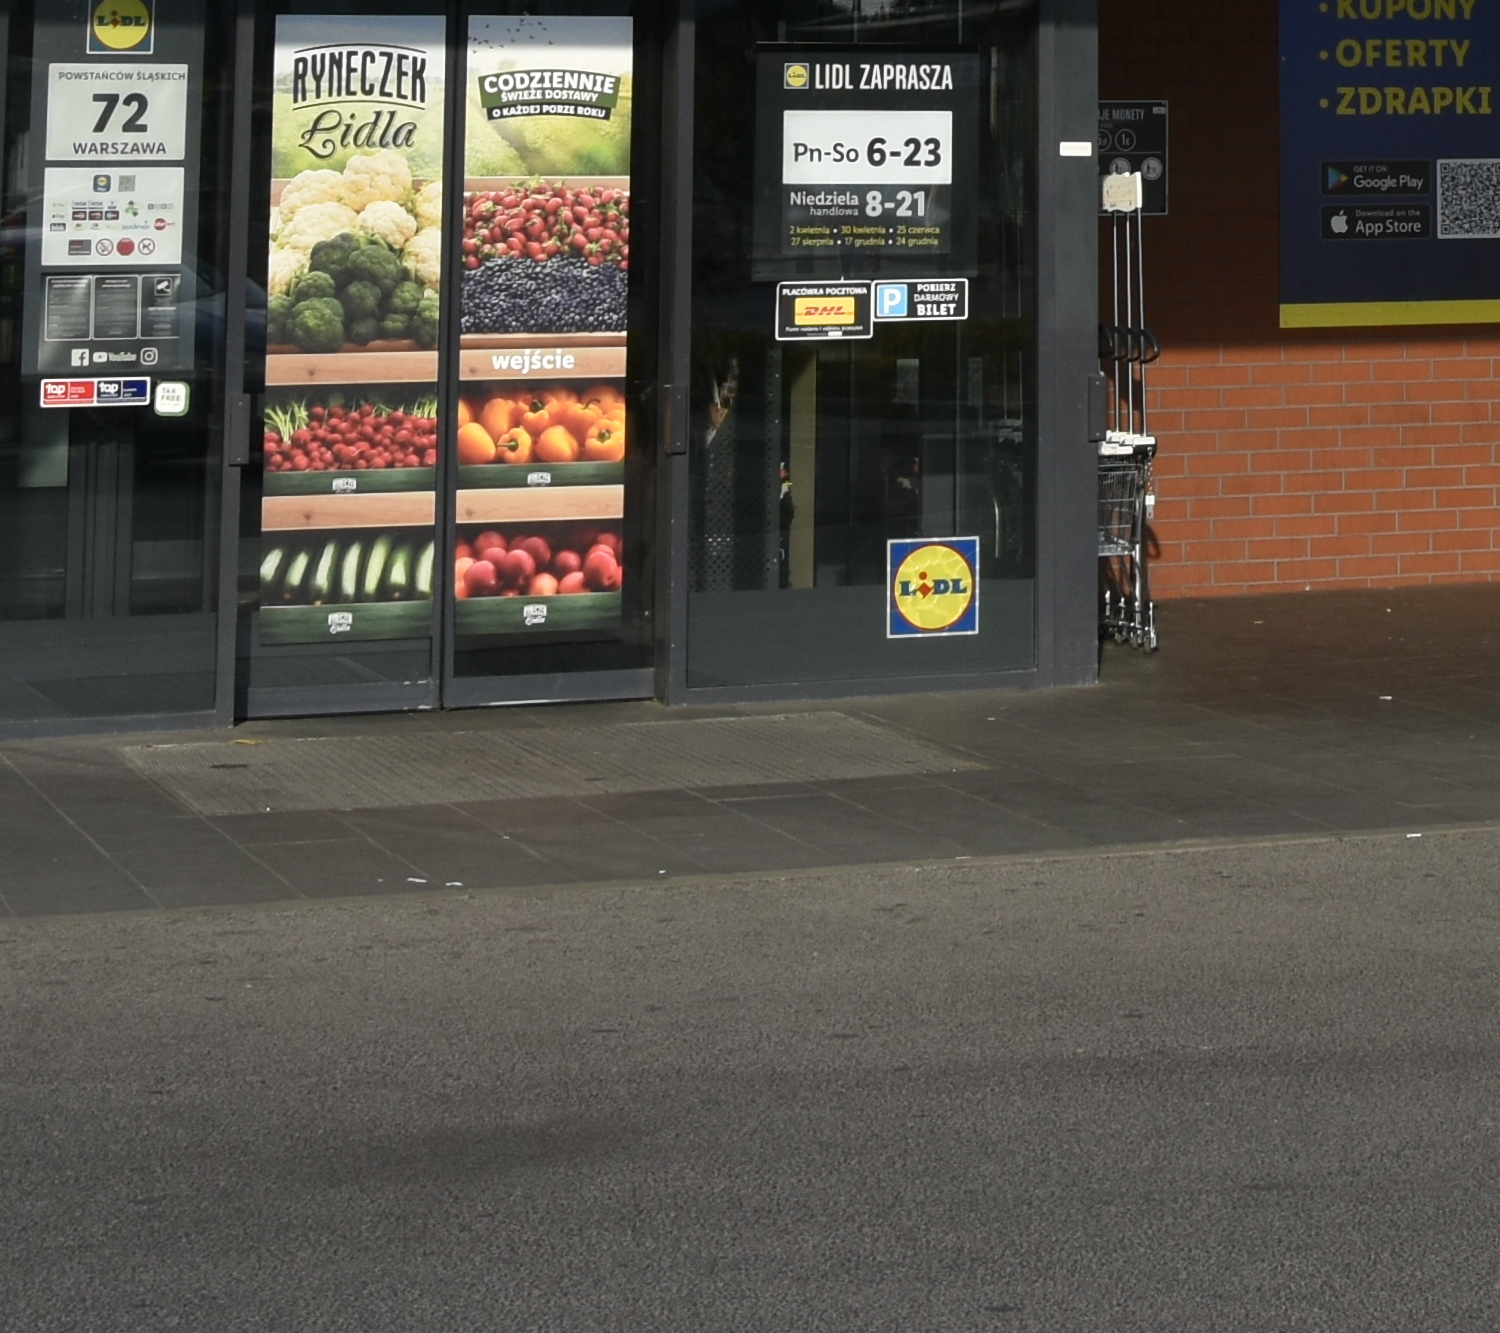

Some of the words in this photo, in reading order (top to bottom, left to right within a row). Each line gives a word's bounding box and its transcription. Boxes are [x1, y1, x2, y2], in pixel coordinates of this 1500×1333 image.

[96, 10, 146, 28] LIDL
[1335, 39, 1471, 68] OFERTY
[58, 71, 134, 81] POWSTAŃCÓW
[137, 71, 186, 82] ŚLĄSKICH
[292, 50, 427, 103] RYNECZEK
[483, 72, 616, 94] CODZIENNIE
[814, 64, 854, 90] LIDL
[859, 64, 953, 90] ZAPRASZA
[501, 88, 543, 102] ŚWIEŻE
[545, 90, 599, 103] DOSTAWY
[1335, 86, 1492, 115] ZDRAPKI
[92, 92, 149, 133] 72
[492, 110, 501, 118] O
[502, 104, 541, 117] KAŻDEJ
[542, 105, 575, 116] PORZE
[577, 106, 606, 118] ROKU
[1112, 109, 1145, 120] MONETY
[298, 110, 418, 159] Lidla
[72, 142, 167, 155] WARSZAWA
[793, 143, 860, 163] Pn-So
[867, 137, 942, 167] 6-23
[1353, 174, 1397, 191] Google
[1399, 175, 1424, 191] Play
[790, 191, 859, 205] Niedziela
[865, 190, 926, 217] 8-21
[810, 207, 859, 216] handlowa
[790, 226, 795, 234] 2
[796, 226, 830, 234] kwietnia
[841, 226, 851, 234] 30
[853, 226, 886, 234] kwietnia
[896, 226, 906, 234] 25
[1355, 218, 1383, 236] App
[1384, 218, 1422, 234] Store
[791, 237, 801, 245] 27
[844, 237, 853, 245] 17
[854, 237, 885, 247] grudnia
[896, 237, 906, 245] 24
[907, 237, 938, 247] grudnia
[917, 284, 955, 292] POBIERZ
[883, 288, 901, 313] P
[917, 303, 956, 315] BILET
[803, 306, 846, 316] DHL
[491, 349, 575, 374] wejście
[899, 571, 967, 600] LIDL
